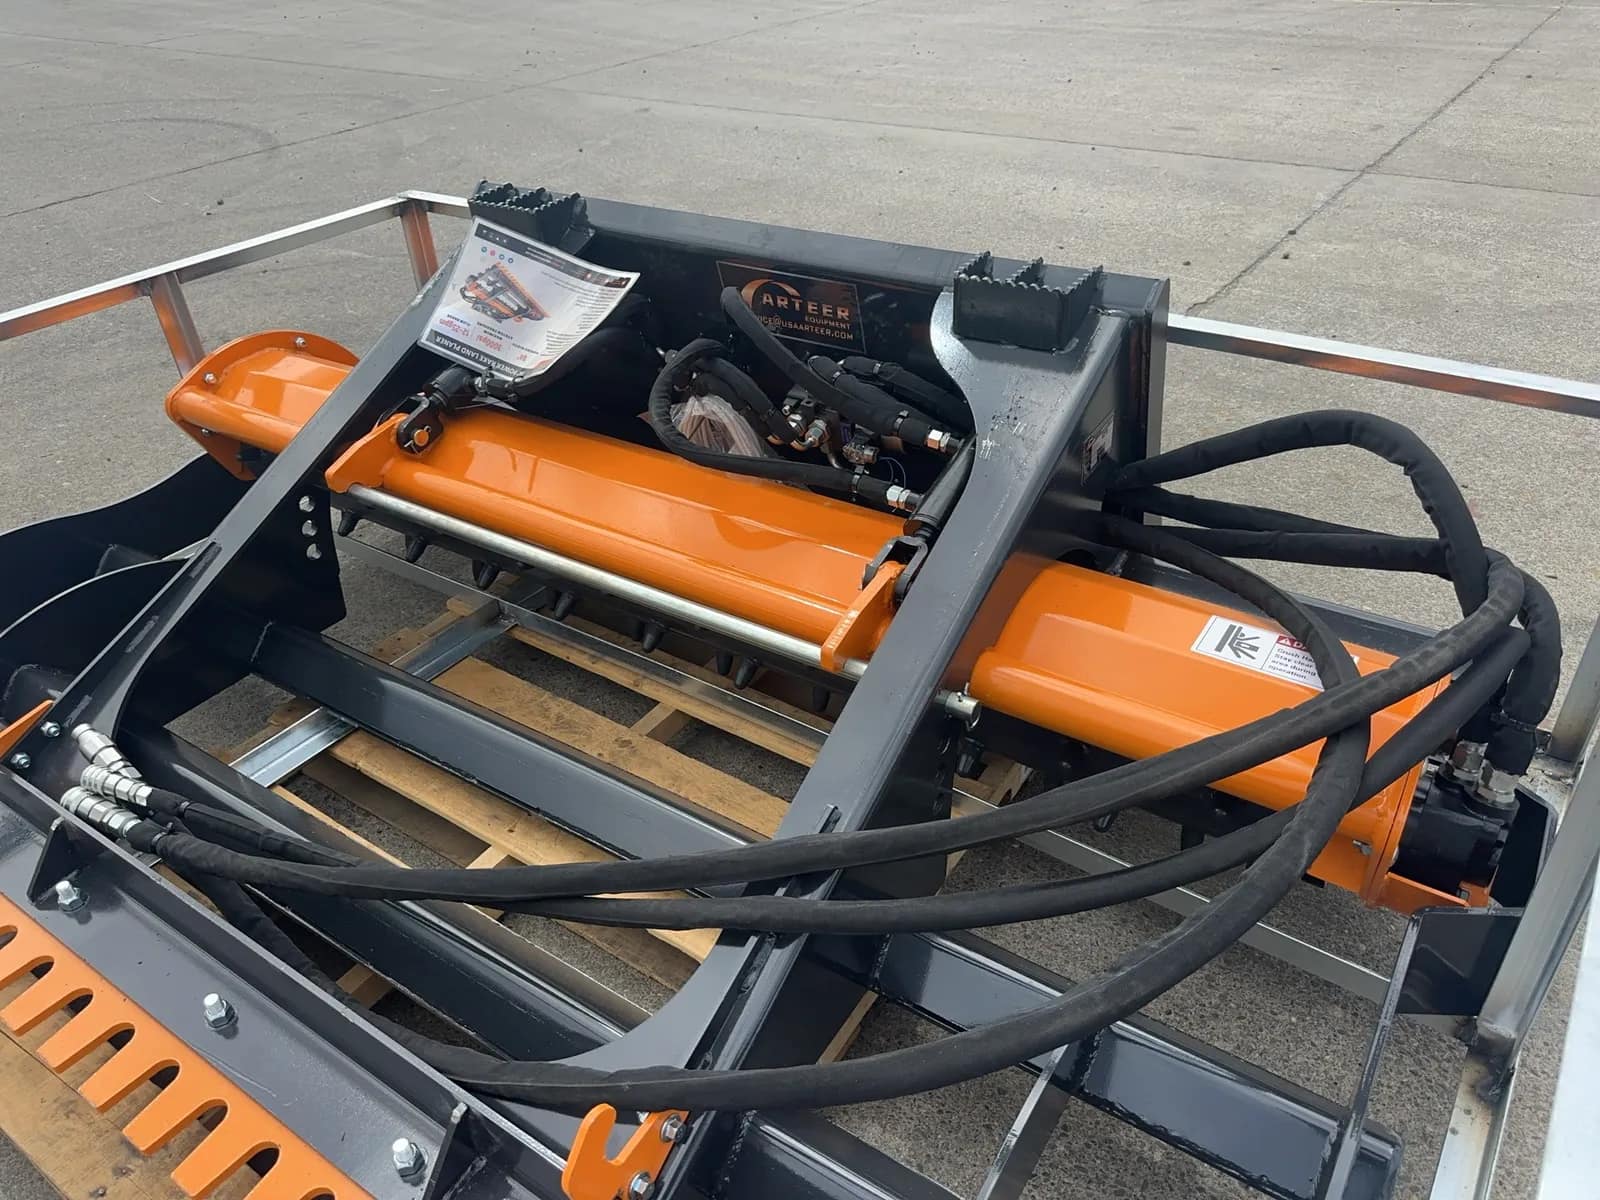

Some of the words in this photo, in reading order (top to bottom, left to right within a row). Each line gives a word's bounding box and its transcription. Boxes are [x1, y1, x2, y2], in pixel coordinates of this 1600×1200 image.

[762, 293, 850, 320] ARTEER
[757, 314, 854, 340] ICE@USAARTEER.COM
[805, 316, 851, 330] EQUIPMENT
[435, 335, 461, 351] PLANER
[461, 346, 480, 360] LAND
[1274, 653, 1291, 662] Stay
[1294, 660, 1313, 668] clear
[1277, 648, 1300, 659] Crush
[1271, 659, 1289, 667] area
[1290, 664, 1316, 676] during
